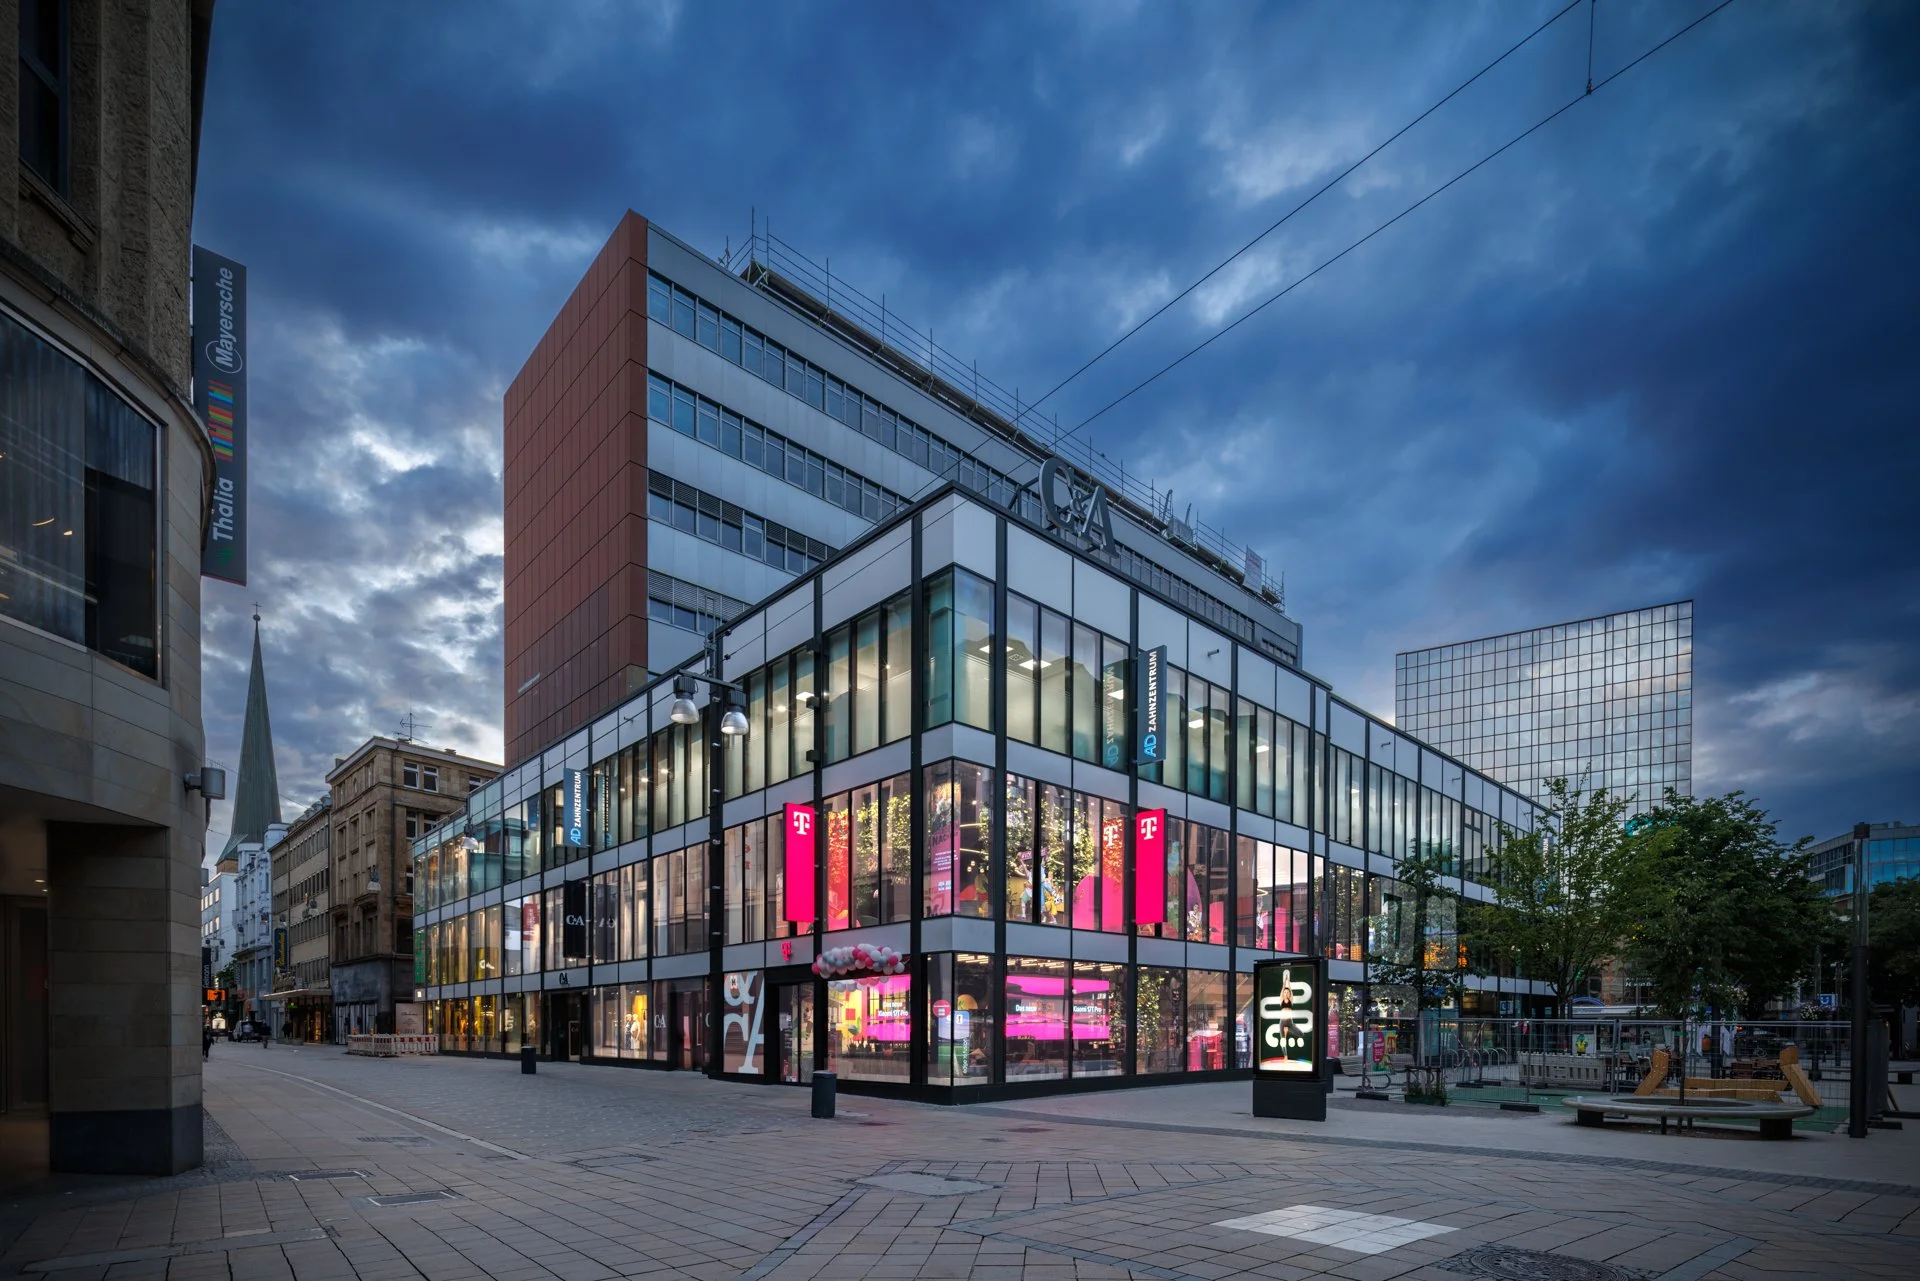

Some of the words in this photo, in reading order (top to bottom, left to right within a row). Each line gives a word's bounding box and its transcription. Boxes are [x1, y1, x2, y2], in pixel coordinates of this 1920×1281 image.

[215, 267, 237, 368] Mayersche
[213, 477, 234, 541] Thalia
[1039, 457, 1121, 560] C&A
[1148, 650, 1158, 733] ZAHNZENTRUM
[1143, 734, 1157, 758] AD
[574, 771, 582, 828] ZAHNZENTRUM
[793, 811, 810, 836] T
[1140, 816, 1158, 841] T
[570, 828, 582, 846] AD
[566, 914, 585, 926] C&A
[781, 941, 793, 961] T
